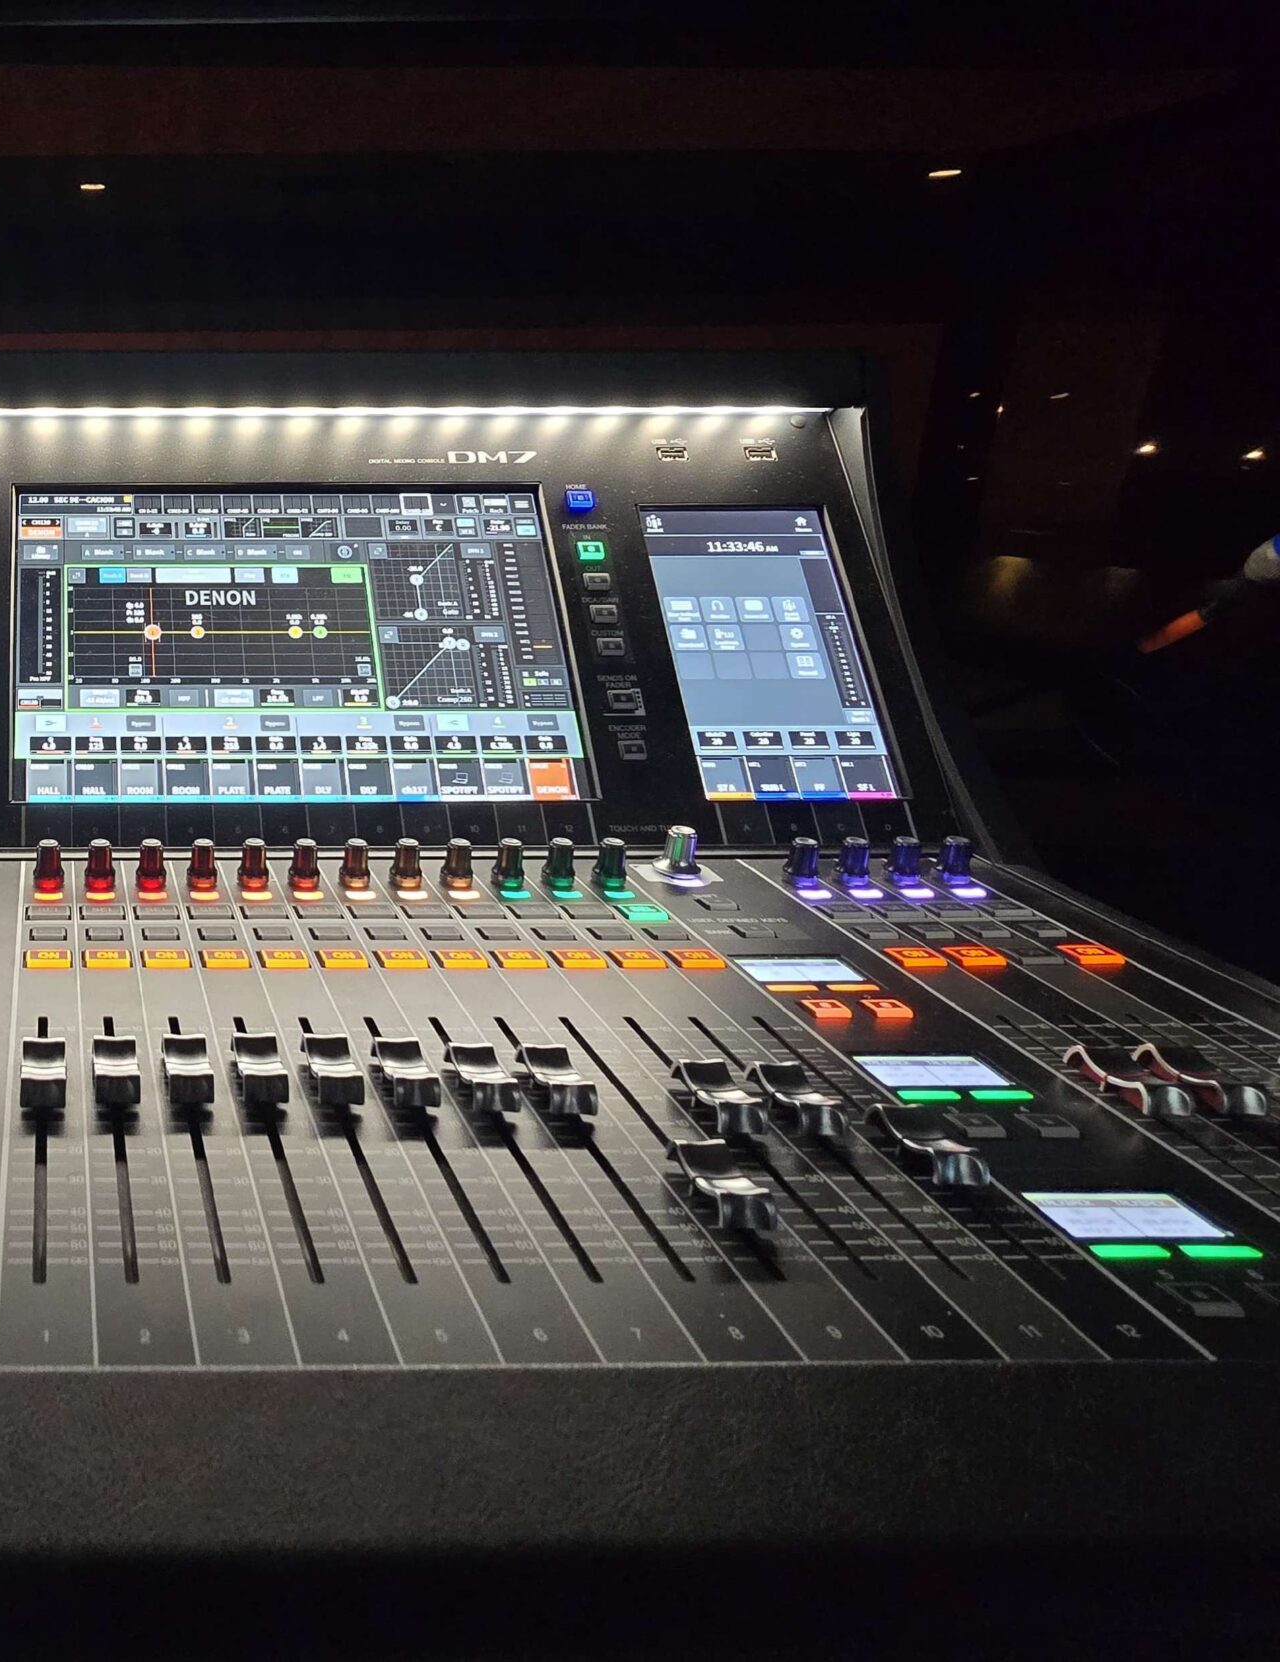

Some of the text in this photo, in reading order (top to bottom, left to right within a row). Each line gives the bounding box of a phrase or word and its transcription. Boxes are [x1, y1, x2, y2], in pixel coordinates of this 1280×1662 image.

[447, 451, 537, 464] DM7
[185, 591, 256, 606] DENON
[441, 786, 478, 795] SPOTIFY
[488, 786, 524, 795] SPOTIFY
[38, 951, 60, 960] ON
[96, 951, 119, 960] ON
[155, 951, 179, 960] ON
[214, 951, 237, 960] ON
[273, 951, 297, 960] ON
[332, 951, 356, 960] ON
[390, 951, 415, 960] ON
[449, 951, 474, 960] ON
[508, 951, 532, 960] ON
[566, 951, 591, 960] ON
[625, 951, 649, 960] ON
[683, 951, 708, 960] ON
[904, 950, 929, 958] ON
[962, 949, 987, 958] ON
[1080, 947, 1106, 956] ON
[337, 1329, 350, 1343] 4
[533, 1328, 549, 1342] 6
[728, 1326, 745, 1341] 8
[826, 1325, 843, 1339] 9
[920, 1325, 944, 1339] 10
